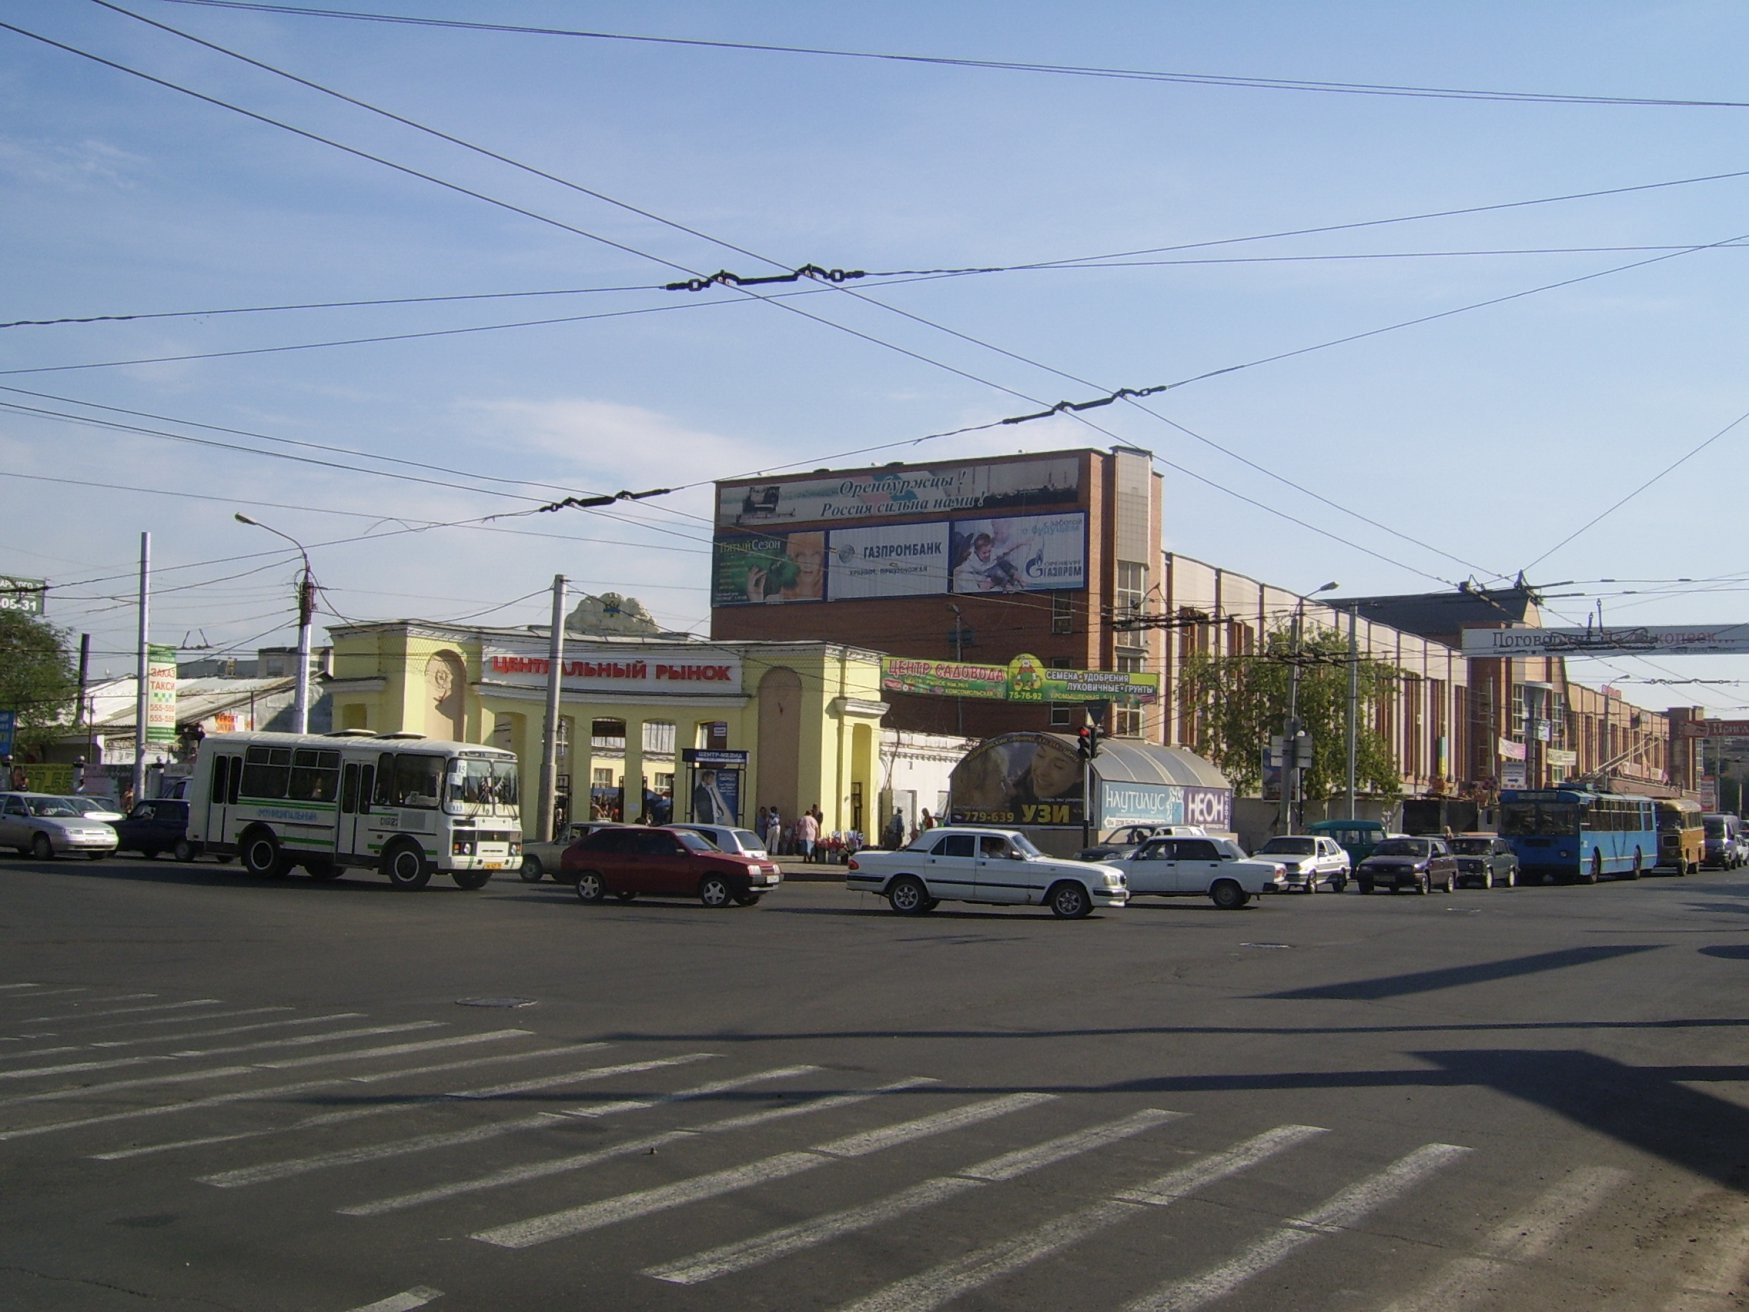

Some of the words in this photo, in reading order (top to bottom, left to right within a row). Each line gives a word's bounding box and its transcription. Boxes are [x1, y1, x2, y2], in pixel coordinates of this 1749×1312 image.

[821, 502, 872, 517] Россия
[877, 499, 929, 514] сильна
[752, 539, 780, 550] Сезон
[863, 542, 942, 559] ГАЗПРОМБАНК
[1043, 566, 1082, 577] ГАЗПРОМ
[150, 667, 176, 678] ЗАКАЗ
[655, 664, 732, 681] РЫНОК
[888, 659, 931, 678] ЦЕНТР
[935, 663, 1006, 683] САДОВОДА
[1046, 671, 1079, 681] СЕМЕНА
[1083, 673, 1129, 682] УДОБРЕНИЯ
[149, 681, 175, 690] ТАКСИ
[1067, 682, 1120, 693] ЛУКОВИЧНЫЕ
[1124, 684, 1154, 694] ГРУНТЫ
[964, 811, 1015, 823] 779-639
[1021, 804, 1071, 824] УЗИ
[1188, 792, 1224, 823] НЕОН
